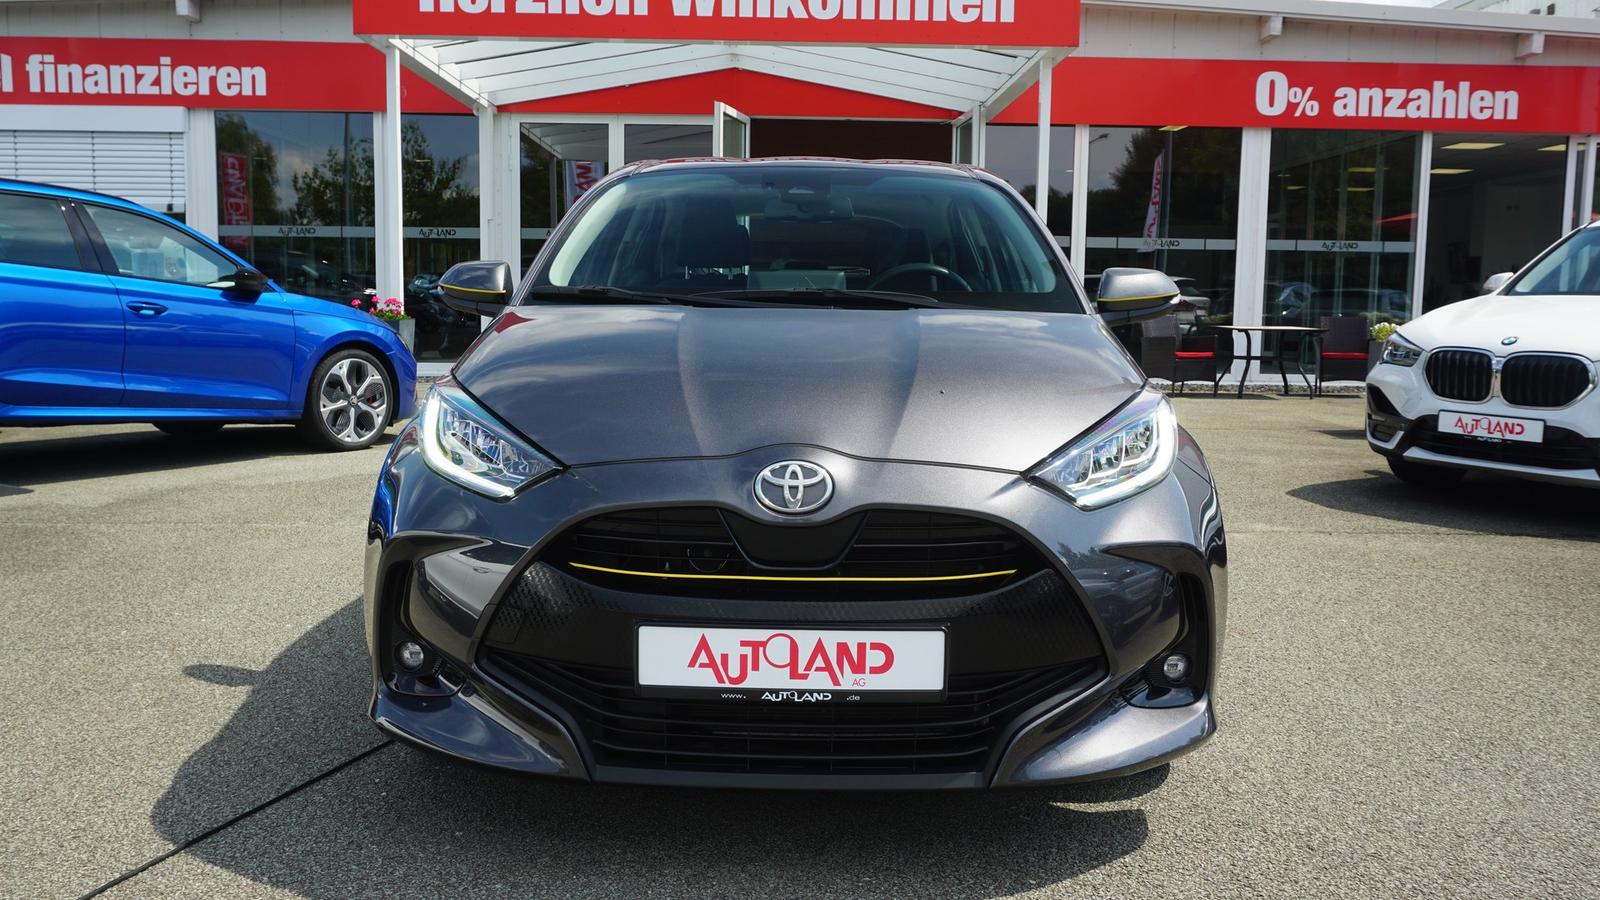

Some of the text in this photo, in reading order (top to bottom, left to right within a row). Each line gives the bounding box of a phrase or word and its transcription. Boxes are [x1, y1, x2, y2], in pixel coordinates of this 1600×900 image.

[26, 53, 267, 97] finanzieren
[1255, 70, 1519, 120] 0% anzahlen
[1454, 415, 1525, 438] AUTOLAND
[687, 632, 895, 687] AUTOLAND
[761, 690, 832, 702] AUTOLAND
[852, 678, 866, 687] AG
